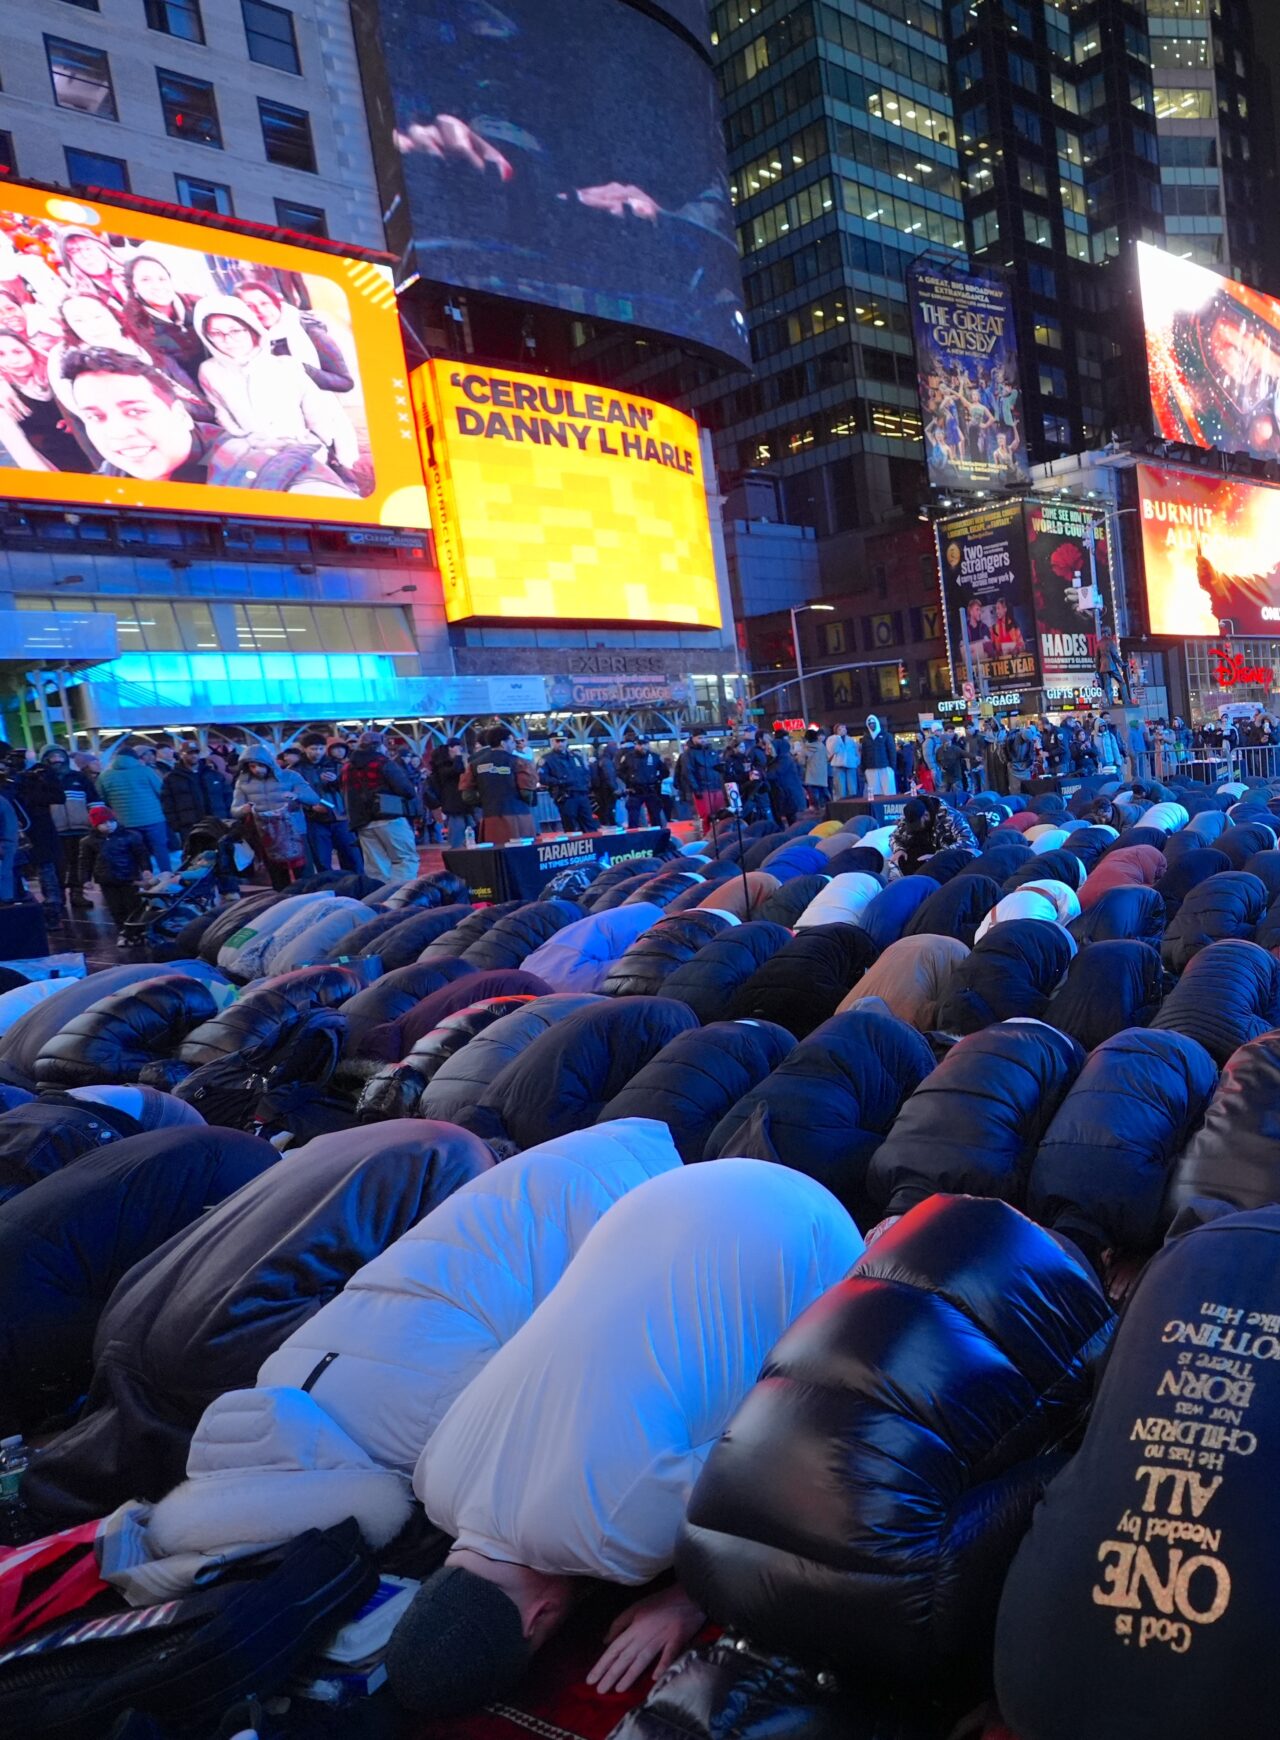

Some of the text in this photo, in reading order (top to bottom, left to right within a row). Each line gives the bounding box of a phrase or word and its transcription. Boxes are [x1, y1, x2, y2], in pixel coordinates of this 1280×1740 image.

[919, 302, 1005, 337] THE GREAT
[932, 326, 997, 354] GATSBY
[455, 406, 694, 475] DANNY L HARLE
[1041, 507, 1057, 520] COME
[1057, 510, 1070, 522] SEE
[1143, 499, 1193, 526] BURN
[1032, 518, 1063, 535] WORLD
[961, 552, 1010, 575] strangers
[963, 544, 983, 560] two
[567, 656, 664, 673] EXPRESS
[991, 660, 1010, 677] THE
[1010, 656, 1036, 676] YEAR
[572, 685, 609, 702] GIFTS
[619, 684, 669, 701] LUGGAGE
[1046, 686, 1119, 699] GIFTS LUGGE
[937, 699, 967, 712] GIFTS
[537, 838, 594, 862] TARAWEH
[540, 853, 597, 871] IN TIMES SQUARE
[1200, 1302, 1244, 1326] Him
[1177, 1352, 1254, 1381] There is
[1156, 1369, 1256, 1407] BORN
[1175, 1401, 1243, 1425] Nor was
[1130, 1418, 1258, 1456] CHILDREN
[1144, 1445, 1225, 1471] He has no
[1134, 1465, 1223, 1517] ALL
[1117, 1510, 1221, 1551] Needed by
[1092, 1539, 1232, 1625] ONE
[1114, 1613, 1192, 1654] God is
